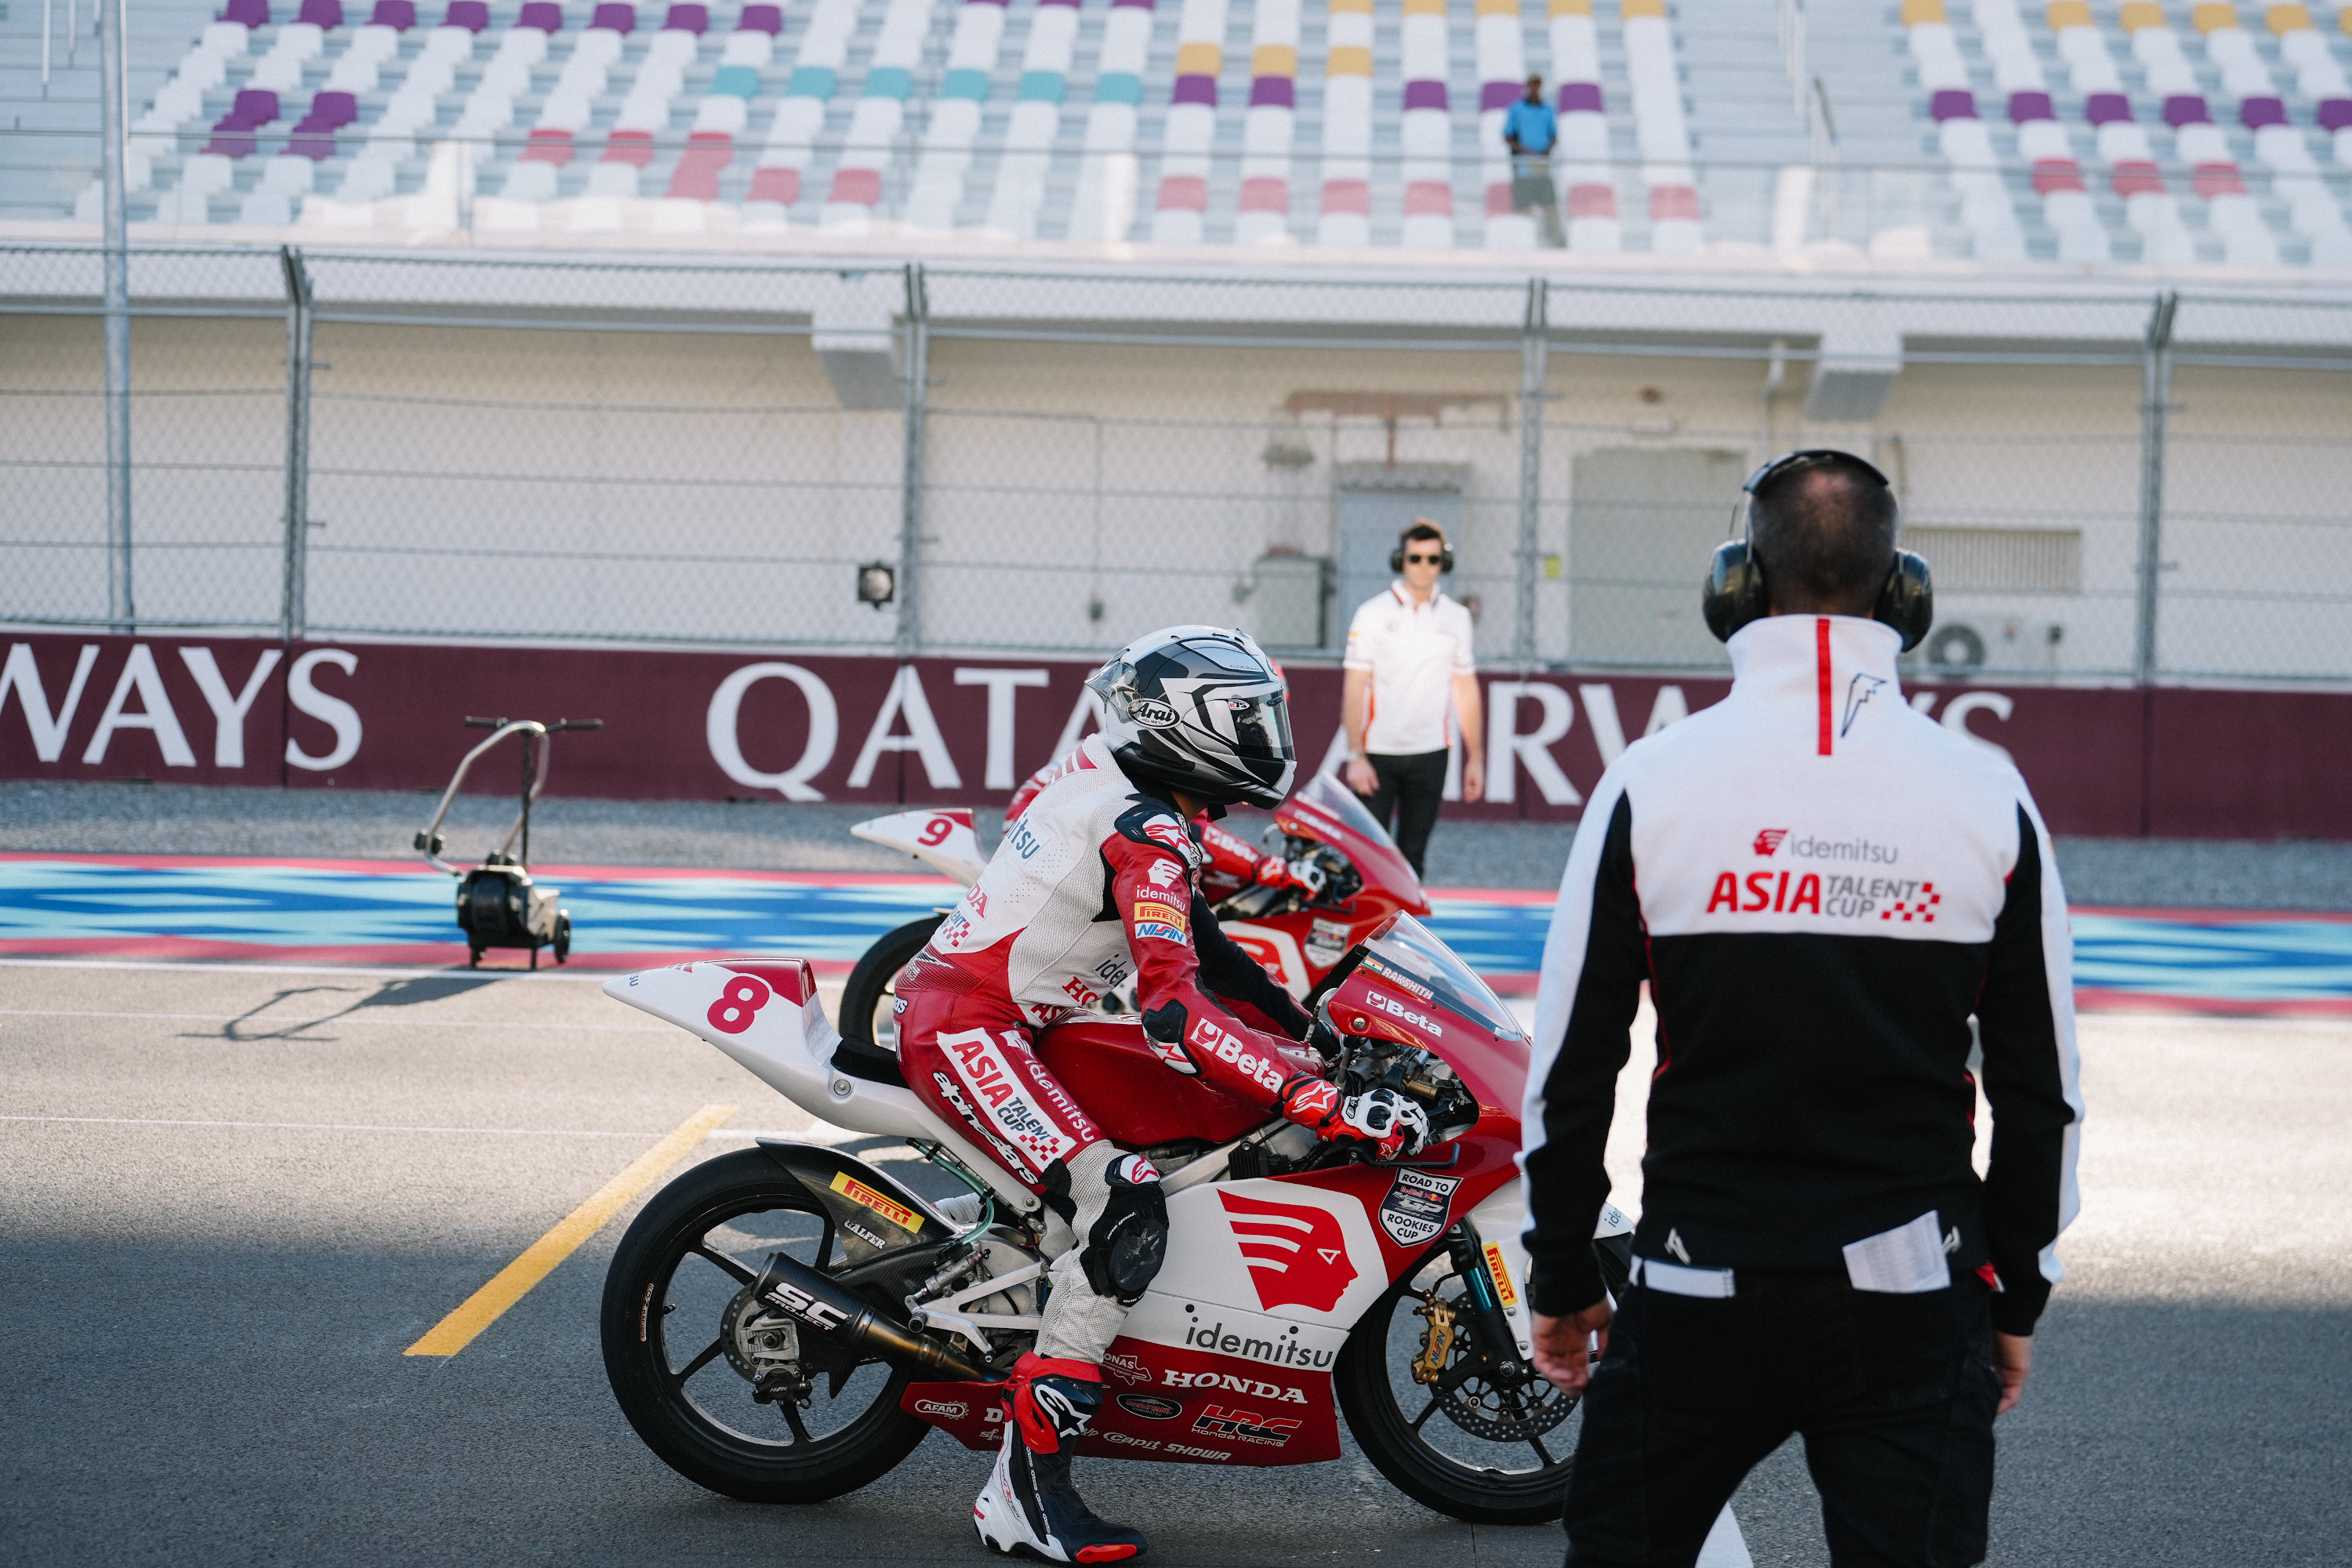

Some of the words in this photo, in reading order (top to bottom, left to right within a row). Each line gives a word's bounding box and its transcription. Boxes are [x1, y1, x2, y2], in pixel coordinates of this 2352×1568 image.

[1136, 702, 1174, 722] Arai
[707, 662, 1106, 802] QAT
[917, 818, 953, 847] 9
[1790, 834, 1899, 863] idemitsu
[1136, 885, 1186, 912] idemitsu
[1706, 870, 1820, 914] ASIA
[1827, 874, 1921, 900] TALENT
[1825, 898, 1875, 917] CUP
[1139, 906, 1183, 927] PIRELLI
[1138, 924, 1185, 942] NISSIN
[1381, 967, 1435, 1000] RAKSHITH
[707, 976, 770, 1034] 8
[1386, 999, 1443, 1038] Beta
[1215, 1033, 1283, 1094] Beta
[951, 1040, 1014, 1109] ASIA
[1007, 1097, 1054, 1141] TALENT
[1024, 1058, 1094, 1142] idemitsu
[932, 1071, 1039, 1186] alpinestars
[996, 1107, 1025, 1133] CUP
[1402, 1174, 1432, 1187] ROAD
[1435, 1181, 1449, 1192] TO
[843, 1179, 913, 1225] PIRELLI
[844, 1219, 887, 1249] GALFER
[1387, 1213, 1434, 1232] ROOKIES
[1396, 1228, 1418, 1239] CUP
[1486, 1247, 1515, 1301] PIRELLI
[764, 1295, 833, 1331] PROJECT
[768, 1283, 848, 1328] SC
[1185, 1316, 1334, 1367] idemitsu
[1431, 1329, 1446, 1366] NISSIN
[1161, 1369, 1308, 1404] HONDA
[923, 1403, 958, 1414] AFAM
[1126, 1400, 1171, 1414] KUSHITANI
[1132, 1406, 1162, 1417] HAMAMATSU
[1191, 1427, 1236, 1440] Honda
[1237, 1436, 1285, 1447] RACING
[1192, 1404, 1302, 1442] HRC
[1163, 1443, 1232, 1461] SHOWA
